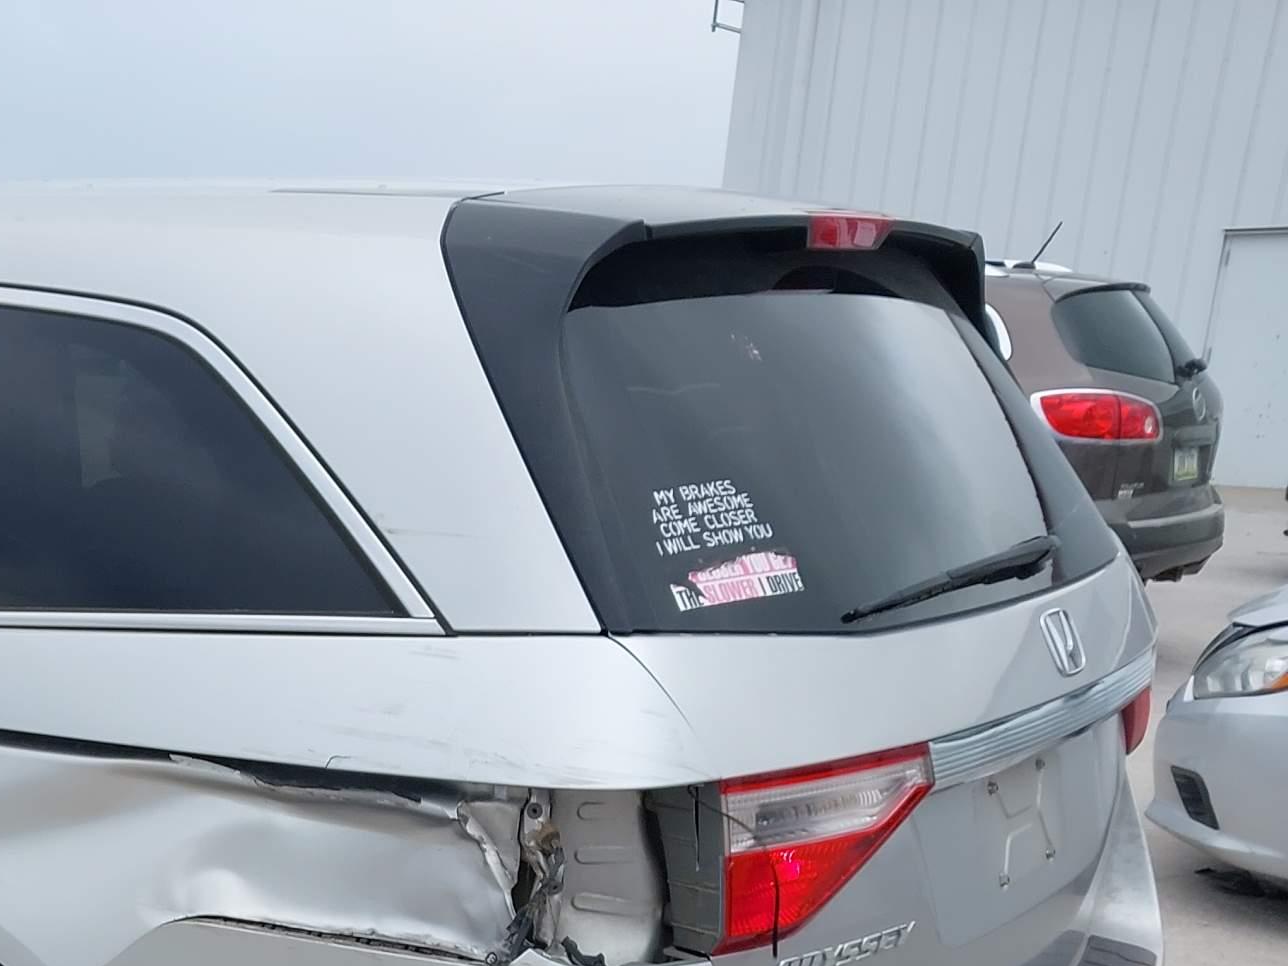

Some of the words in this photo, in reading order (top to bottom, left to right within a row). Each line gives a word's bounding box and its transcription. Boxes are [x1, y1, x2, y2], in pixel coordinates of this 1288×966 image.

[652, 504, 683, 524] ARE
[688, 493, 754, 516] AWESOME
[653, 488, 675, 506] MY
[679, 480, 736, 501] BRAKES
[660, 517, 701, 538] COME
[704, 509, 758, 529] CLOSER
[656, 541, 664, 557] I
[663, 536, 701, 555] WILL
[703, 528, 744, 547] SHOW
[744, 523, 773, 540] YOU
[703, 580, 759, 603] SLOWER
[758, 577, 767, 595] I
[766, 571, 803, 593] DRIVE
